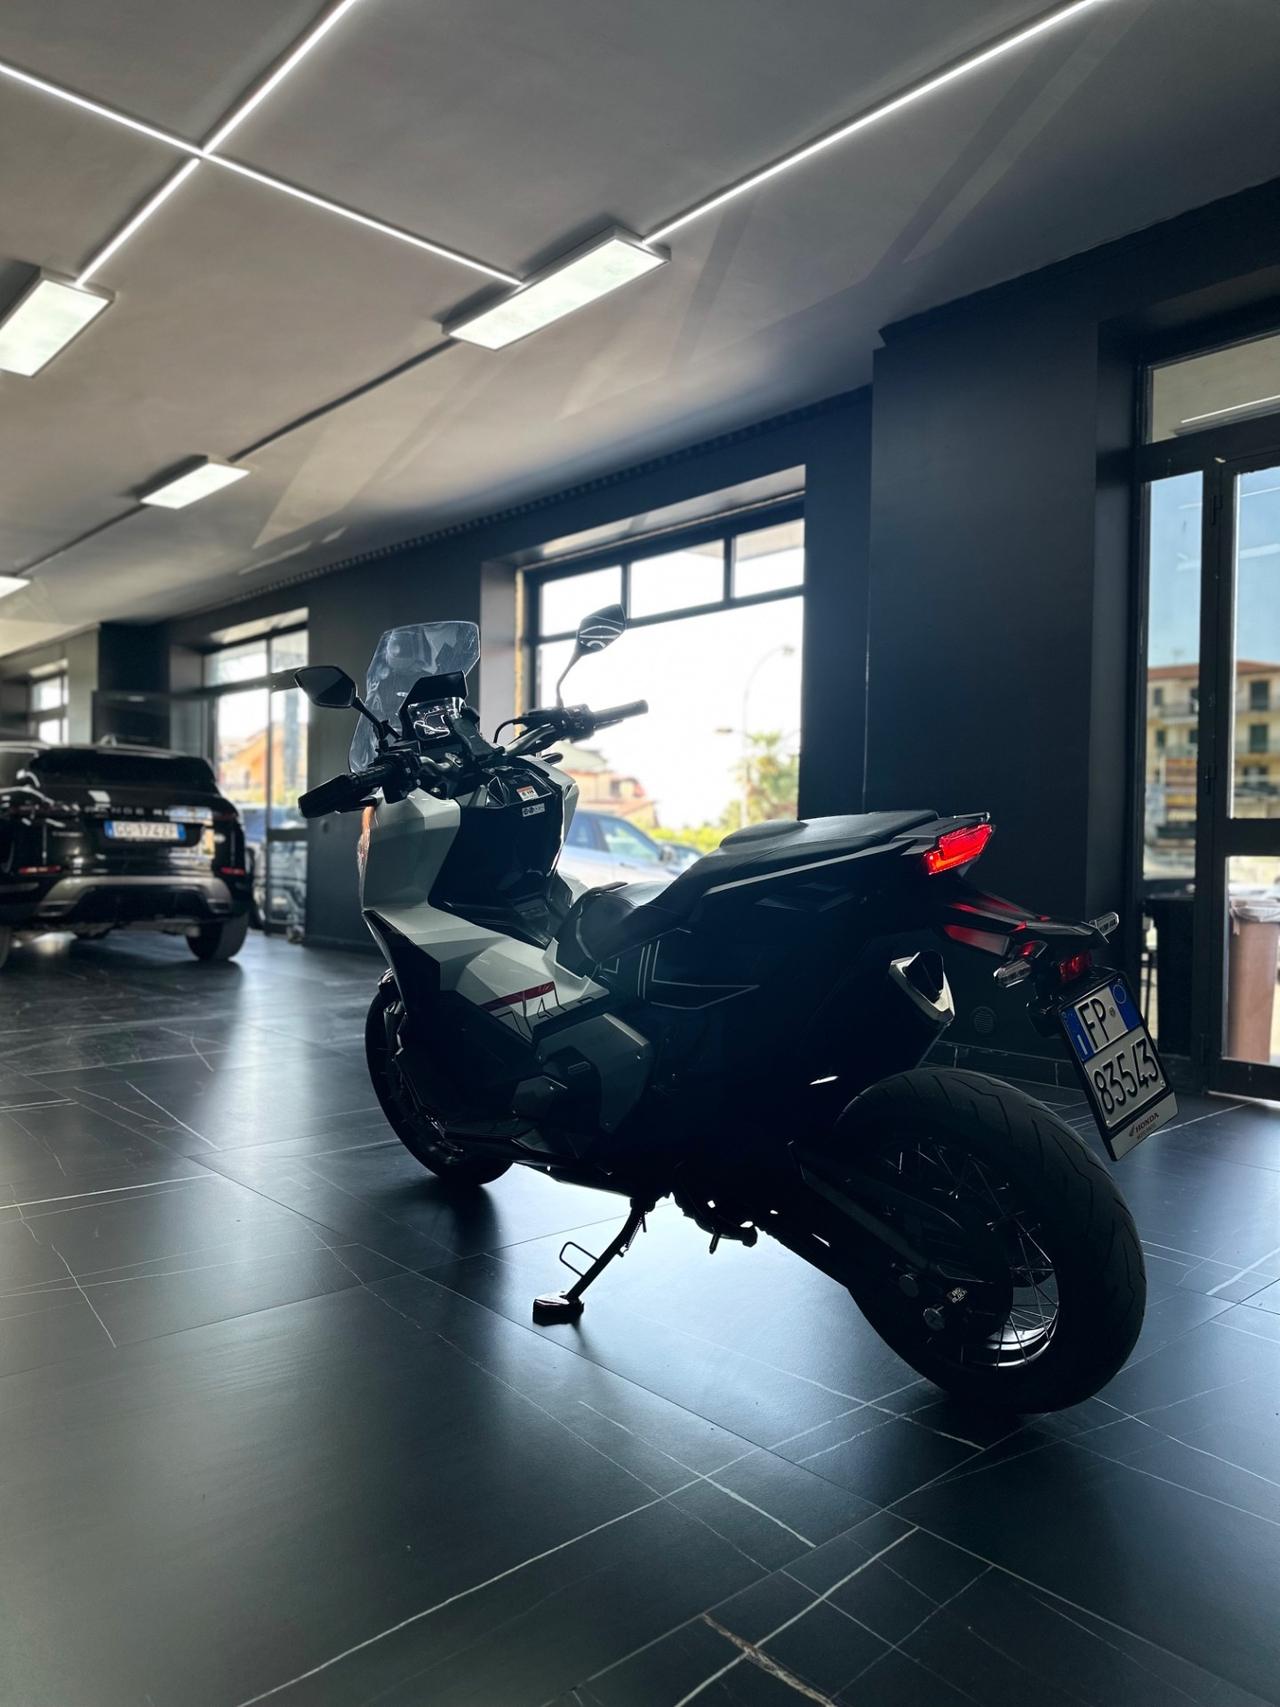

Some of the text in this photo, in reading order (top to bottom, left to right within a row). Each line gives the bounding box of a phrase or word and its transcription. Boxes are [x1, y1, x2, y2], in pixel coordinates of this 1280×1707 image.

[1077, 998, 1110, 1049] FP
[1093, 1038, 1159, 1114] 83543
[1135, 1112, 1160, 1133] HONDA
